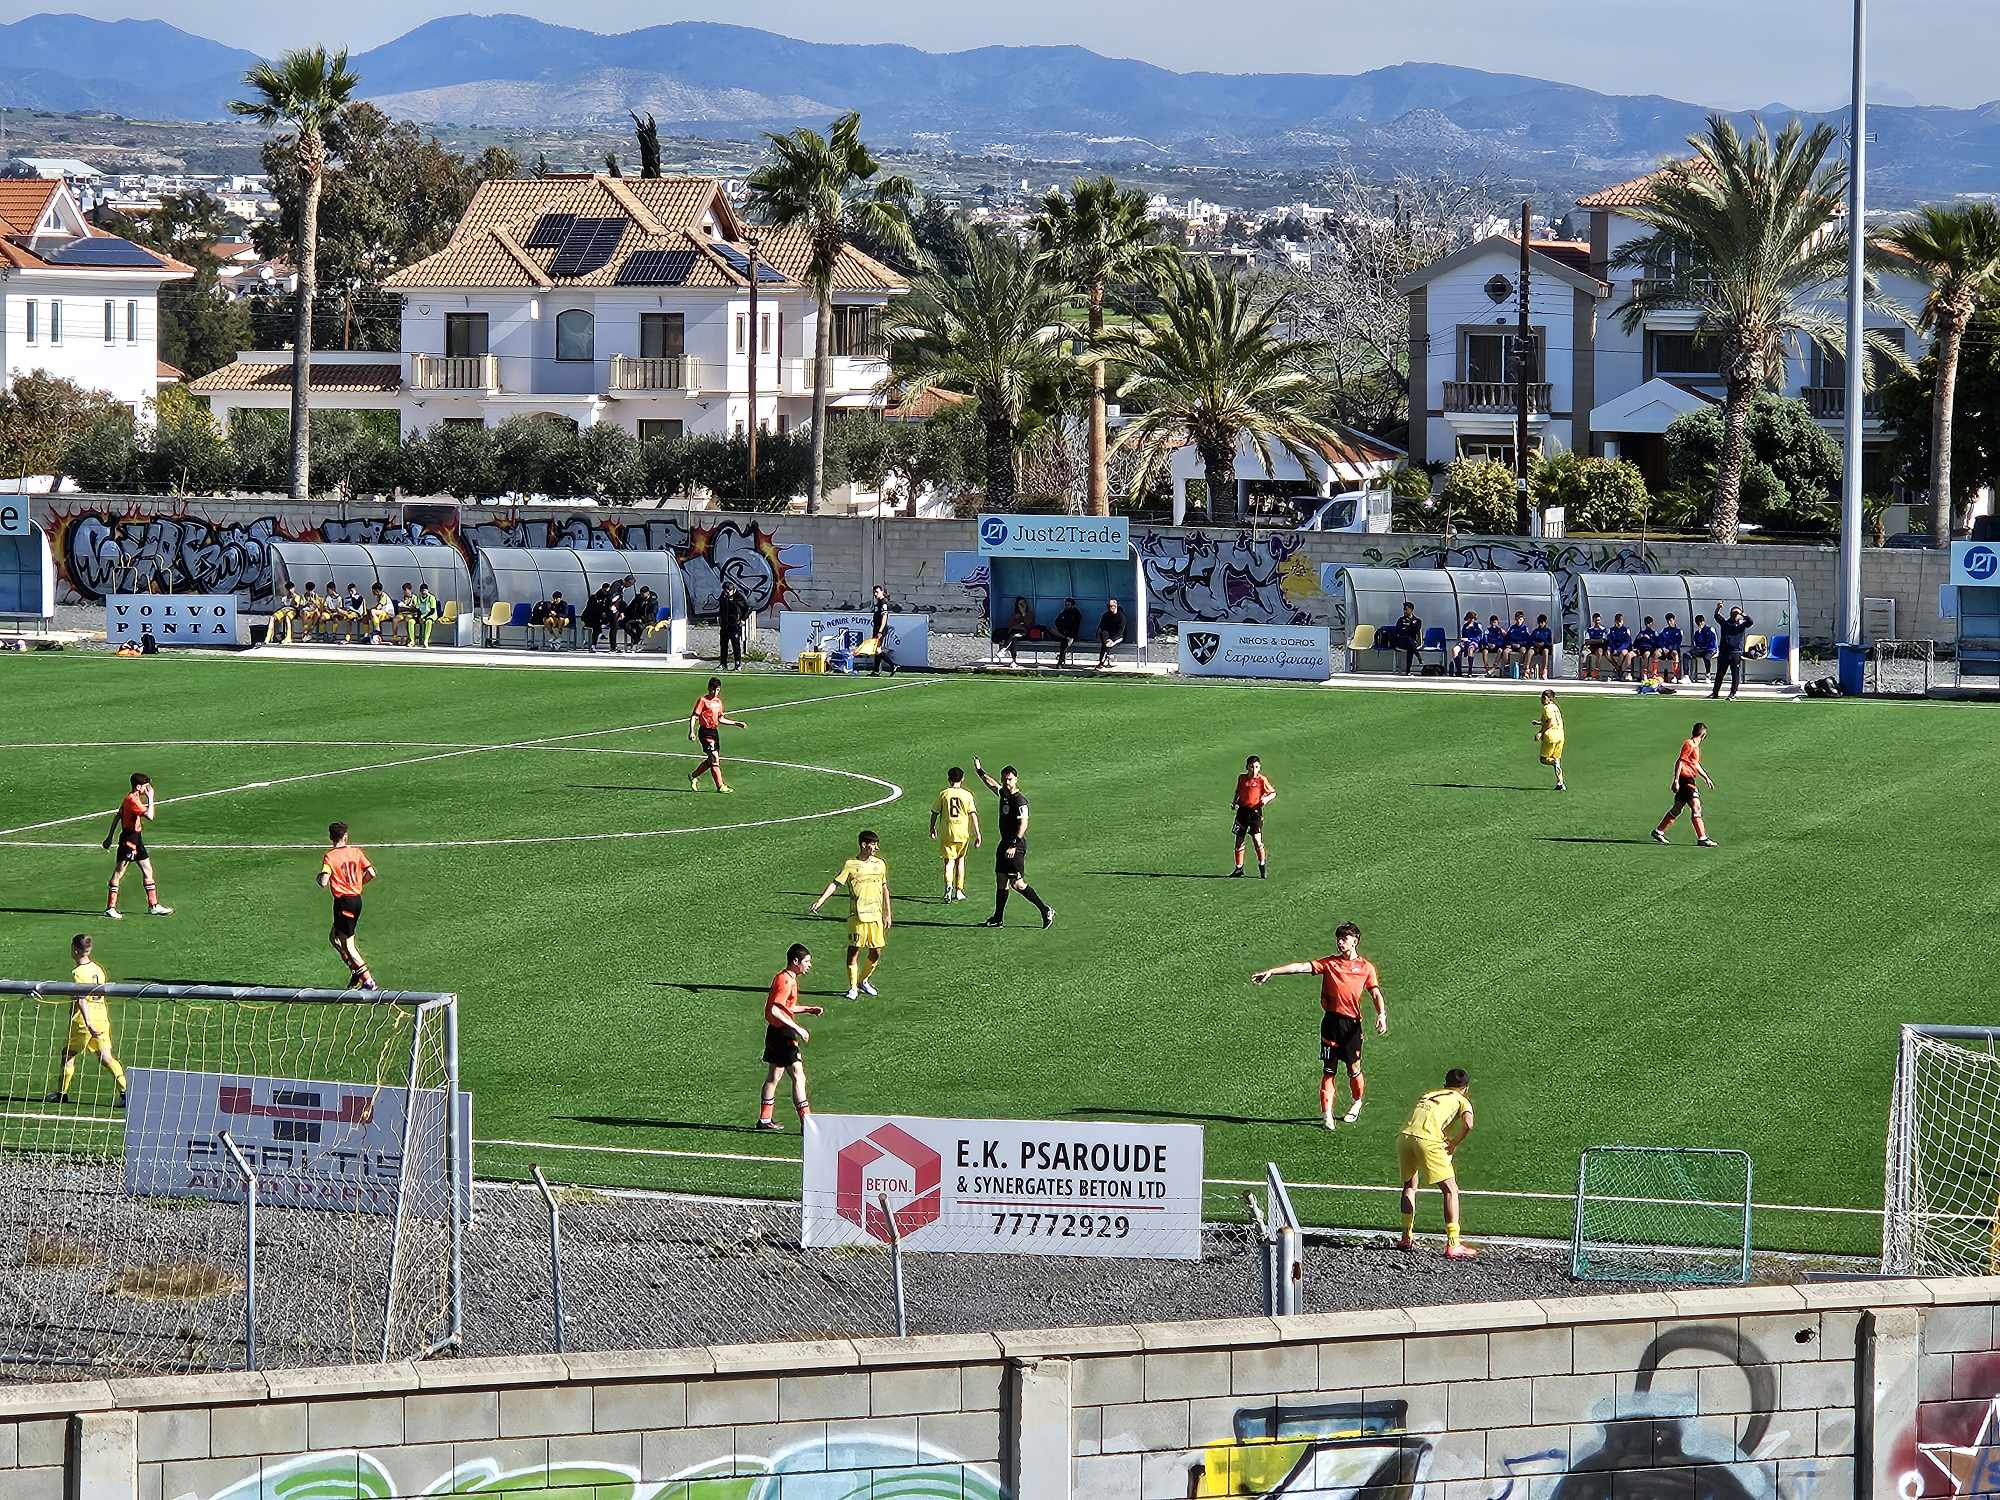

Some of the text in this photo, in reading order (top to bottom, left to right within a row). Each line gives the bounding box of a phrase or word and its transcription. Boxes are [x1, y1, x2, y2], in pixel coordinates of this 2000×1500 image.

[1012, 525, 1121, 543] Just2Trade
[115, 605, 226, 617] VOLVO
[115, 622, 228, 634] PENTA
[1239, 636, 1315, 648] NIKOS & DOROS
[957, 1139, 1167, 1173] E.K. PSAROUDE
[956, 1176, 1166, 1199] & SYNERGATES BETON LTD
[991, 1212, 1130, 1239] 77772929
